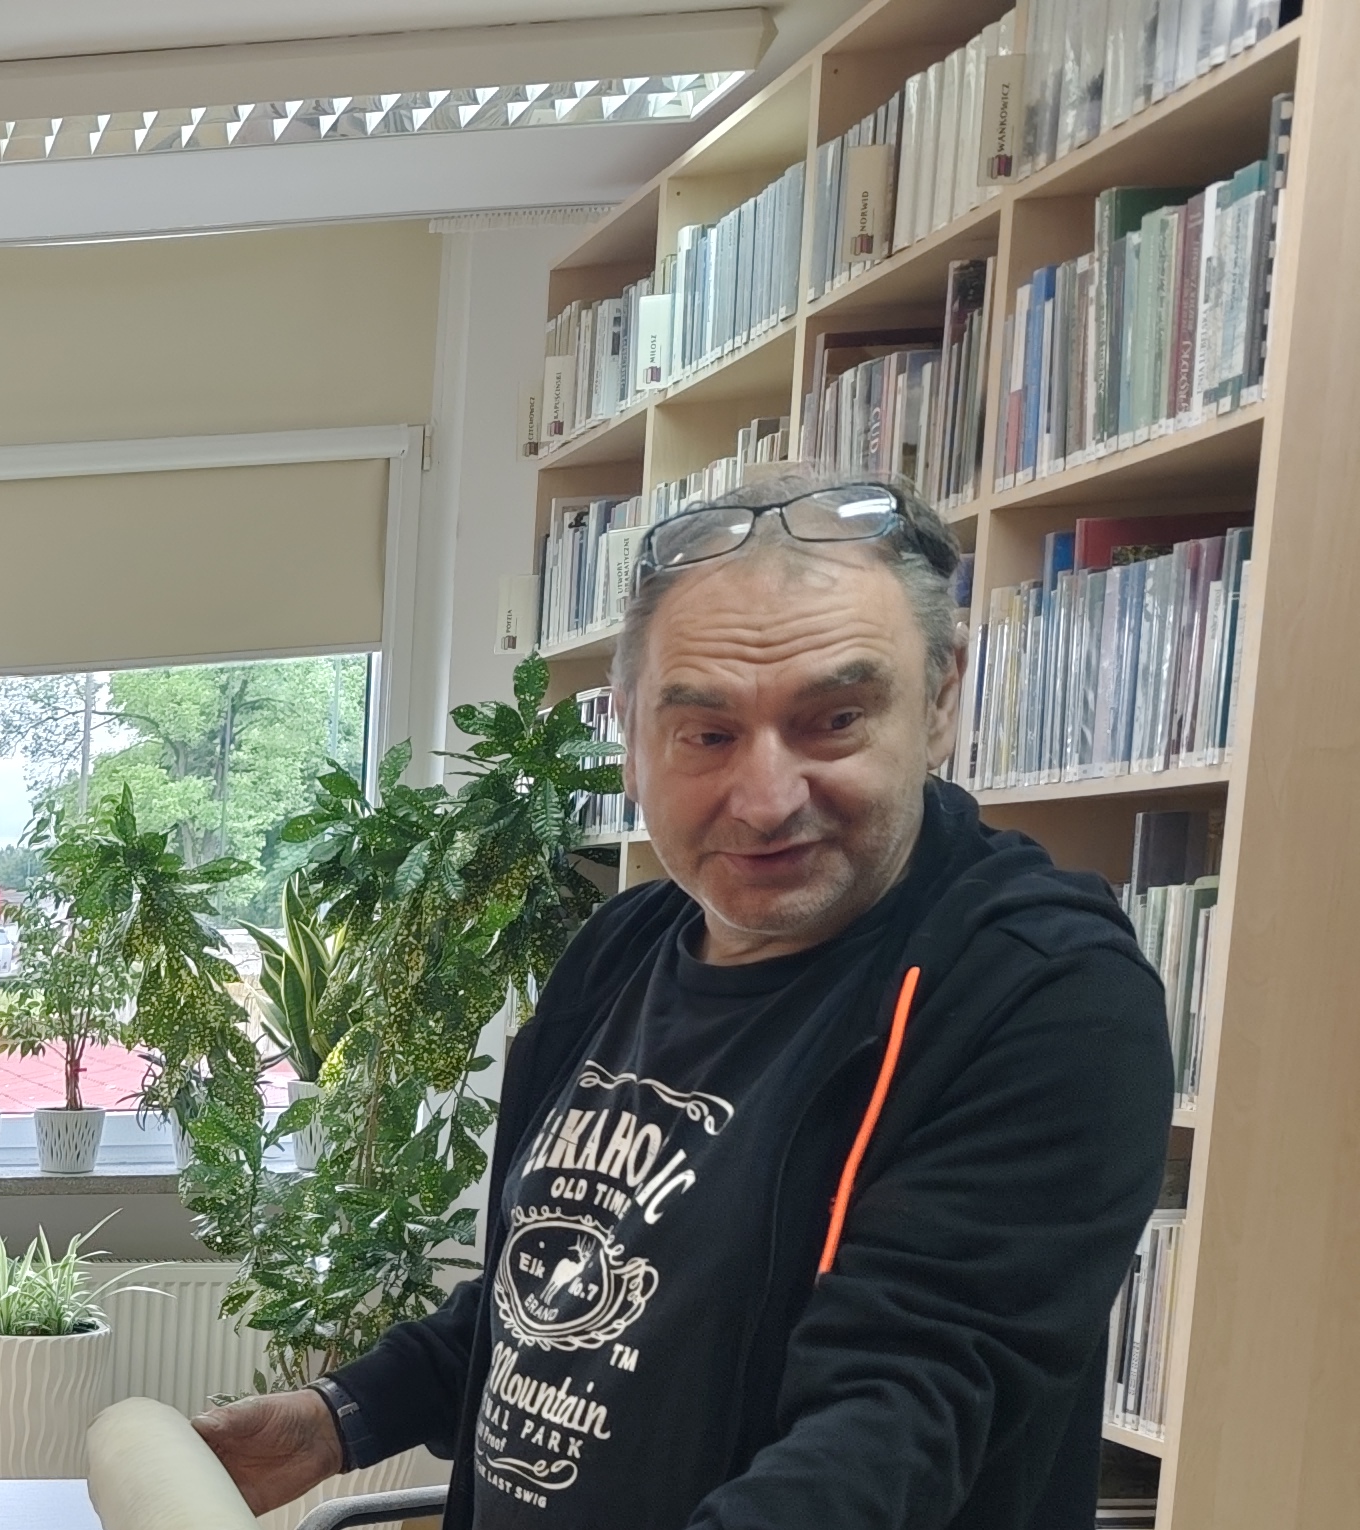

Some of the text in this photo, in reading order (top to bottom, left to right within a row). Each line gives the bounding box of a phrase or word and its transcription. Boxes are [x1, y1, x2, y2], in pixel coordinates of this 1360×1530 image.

[859, 191, 869, 232] NORWID
[550, 1176, 588, 1201] OLD
[519, 1251, 546, 1279] Elk
[524, 1292, 559, 1321] BRAND
[609, 1343, 640, 1373] TM
[489, 1341, 612, 1440] Mountain
[520, 1419, 584, 1459] PARK
[487, 1470, 513, 1493] LAST
[514, 1486, 548, 1508] SWIG
